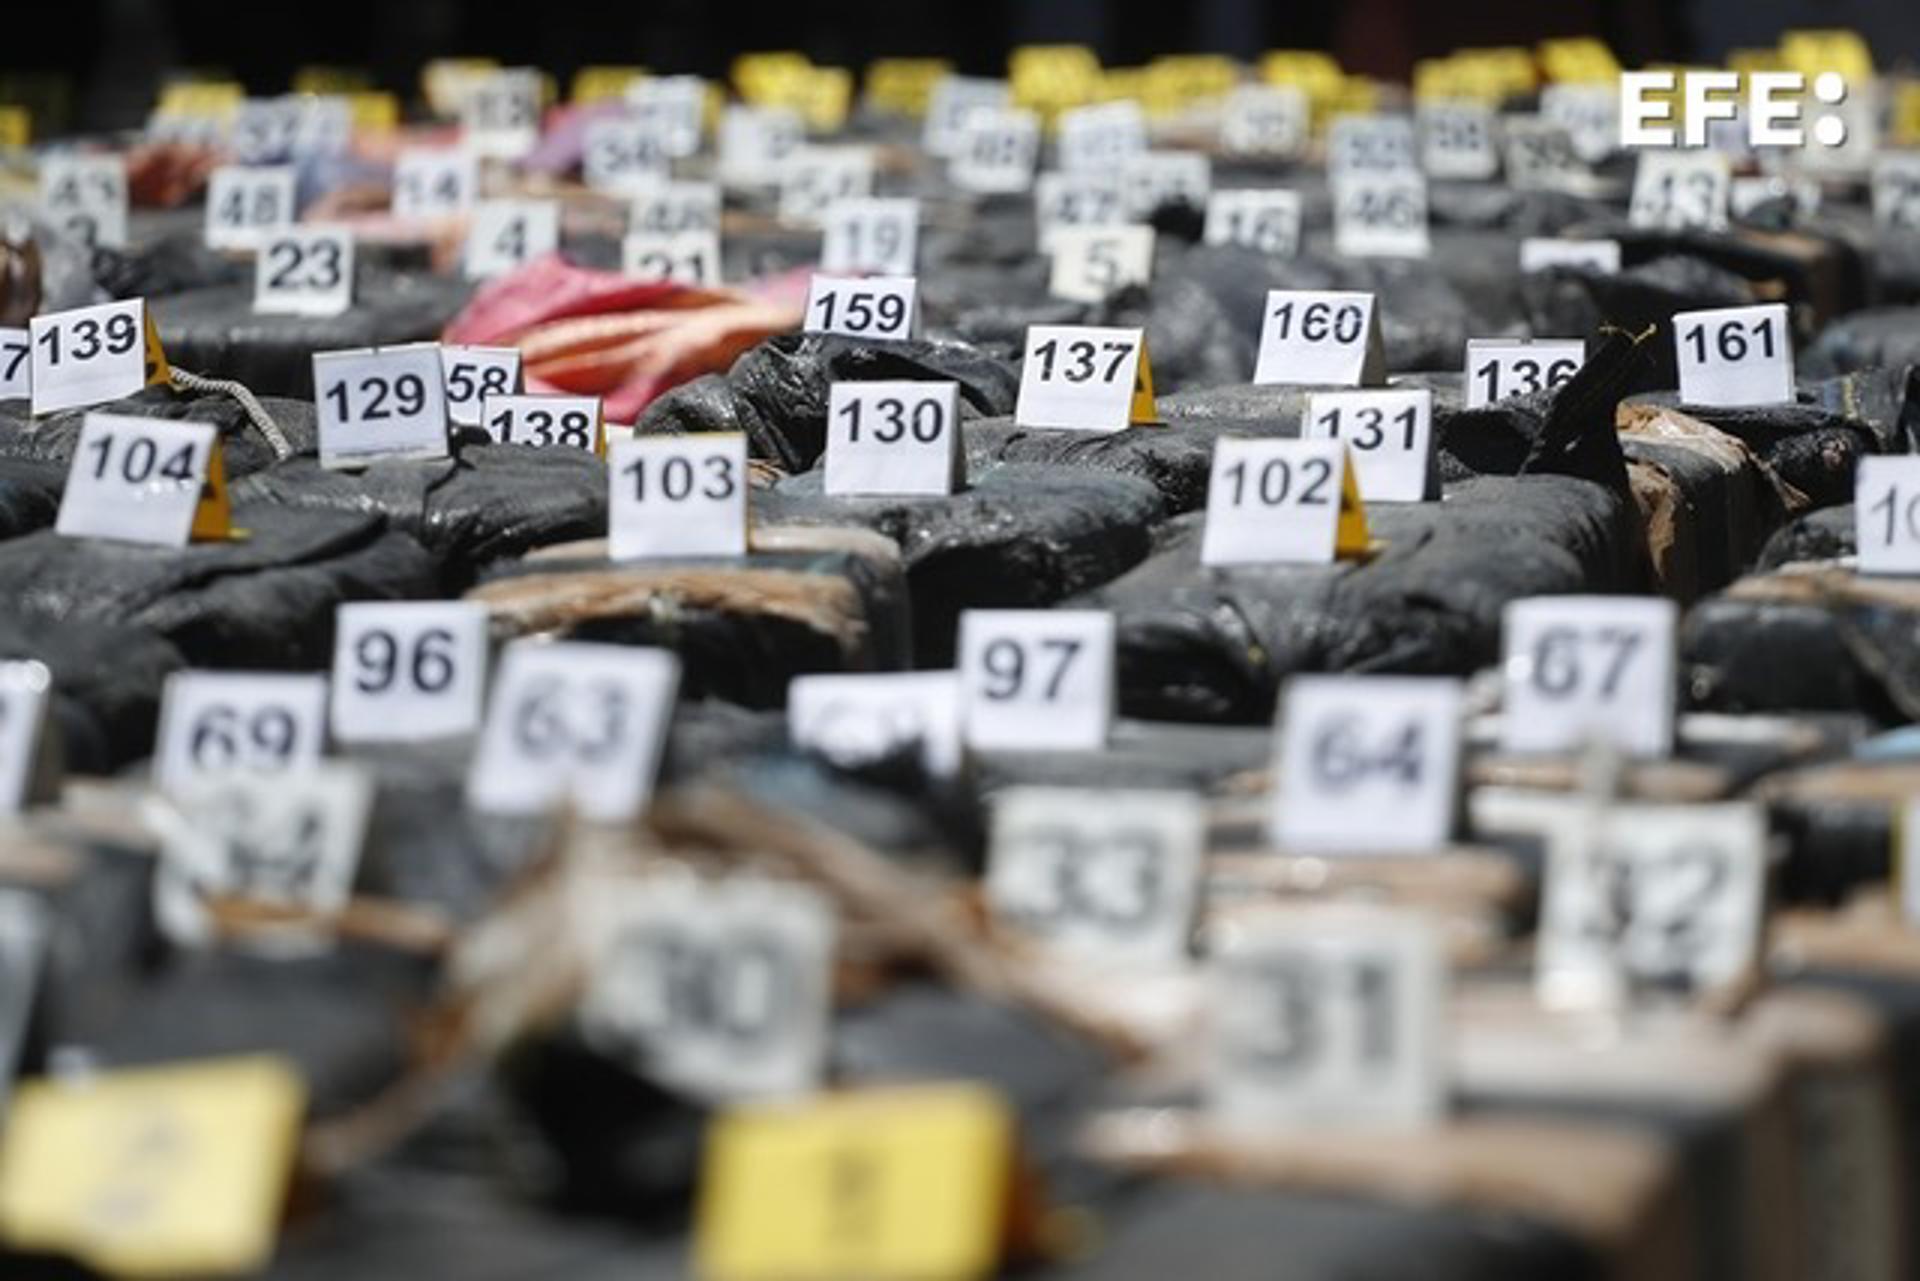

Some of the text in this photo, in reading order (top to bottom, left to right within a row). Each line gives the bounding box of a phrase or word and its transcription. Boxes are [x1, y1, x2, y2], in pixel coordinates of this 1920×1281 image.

[494, 215, 527, 260] 4
[844, 213, 903, 263] 19
[268, 239, 342, 290] 23
[1084, 241, 1119, 289] 5
[817, 291, 906, 333] 159
[1273, 302, 1363, 345] 160
[38, 313, 138, 365] 139
[1033, 339, 1134, 383] 137
[1686, 317, 1775, 364] 161
[325, 373, 425, 423] 129
[1477, 358, 1578, 402] 136
[490, 409, 591, 450] 138
[838, 397, 944, 443] 130
[1318, 406, 1418, 451] 131
[89, 433, 198, 485] 104
[622, 455, 736, 503] 103
[1222, 456, 1333, 507] 102
[354, 628, 456, 696] 96
[982, 638, 1085, 702] 97
[1530, 627, 1643, 698] 67
[189, 704, 298, 767] 69
[512, 675, 634, 765] 63
[1309, 710, 1427, 792] 64
[1010, 824, 1167, 943] 33
